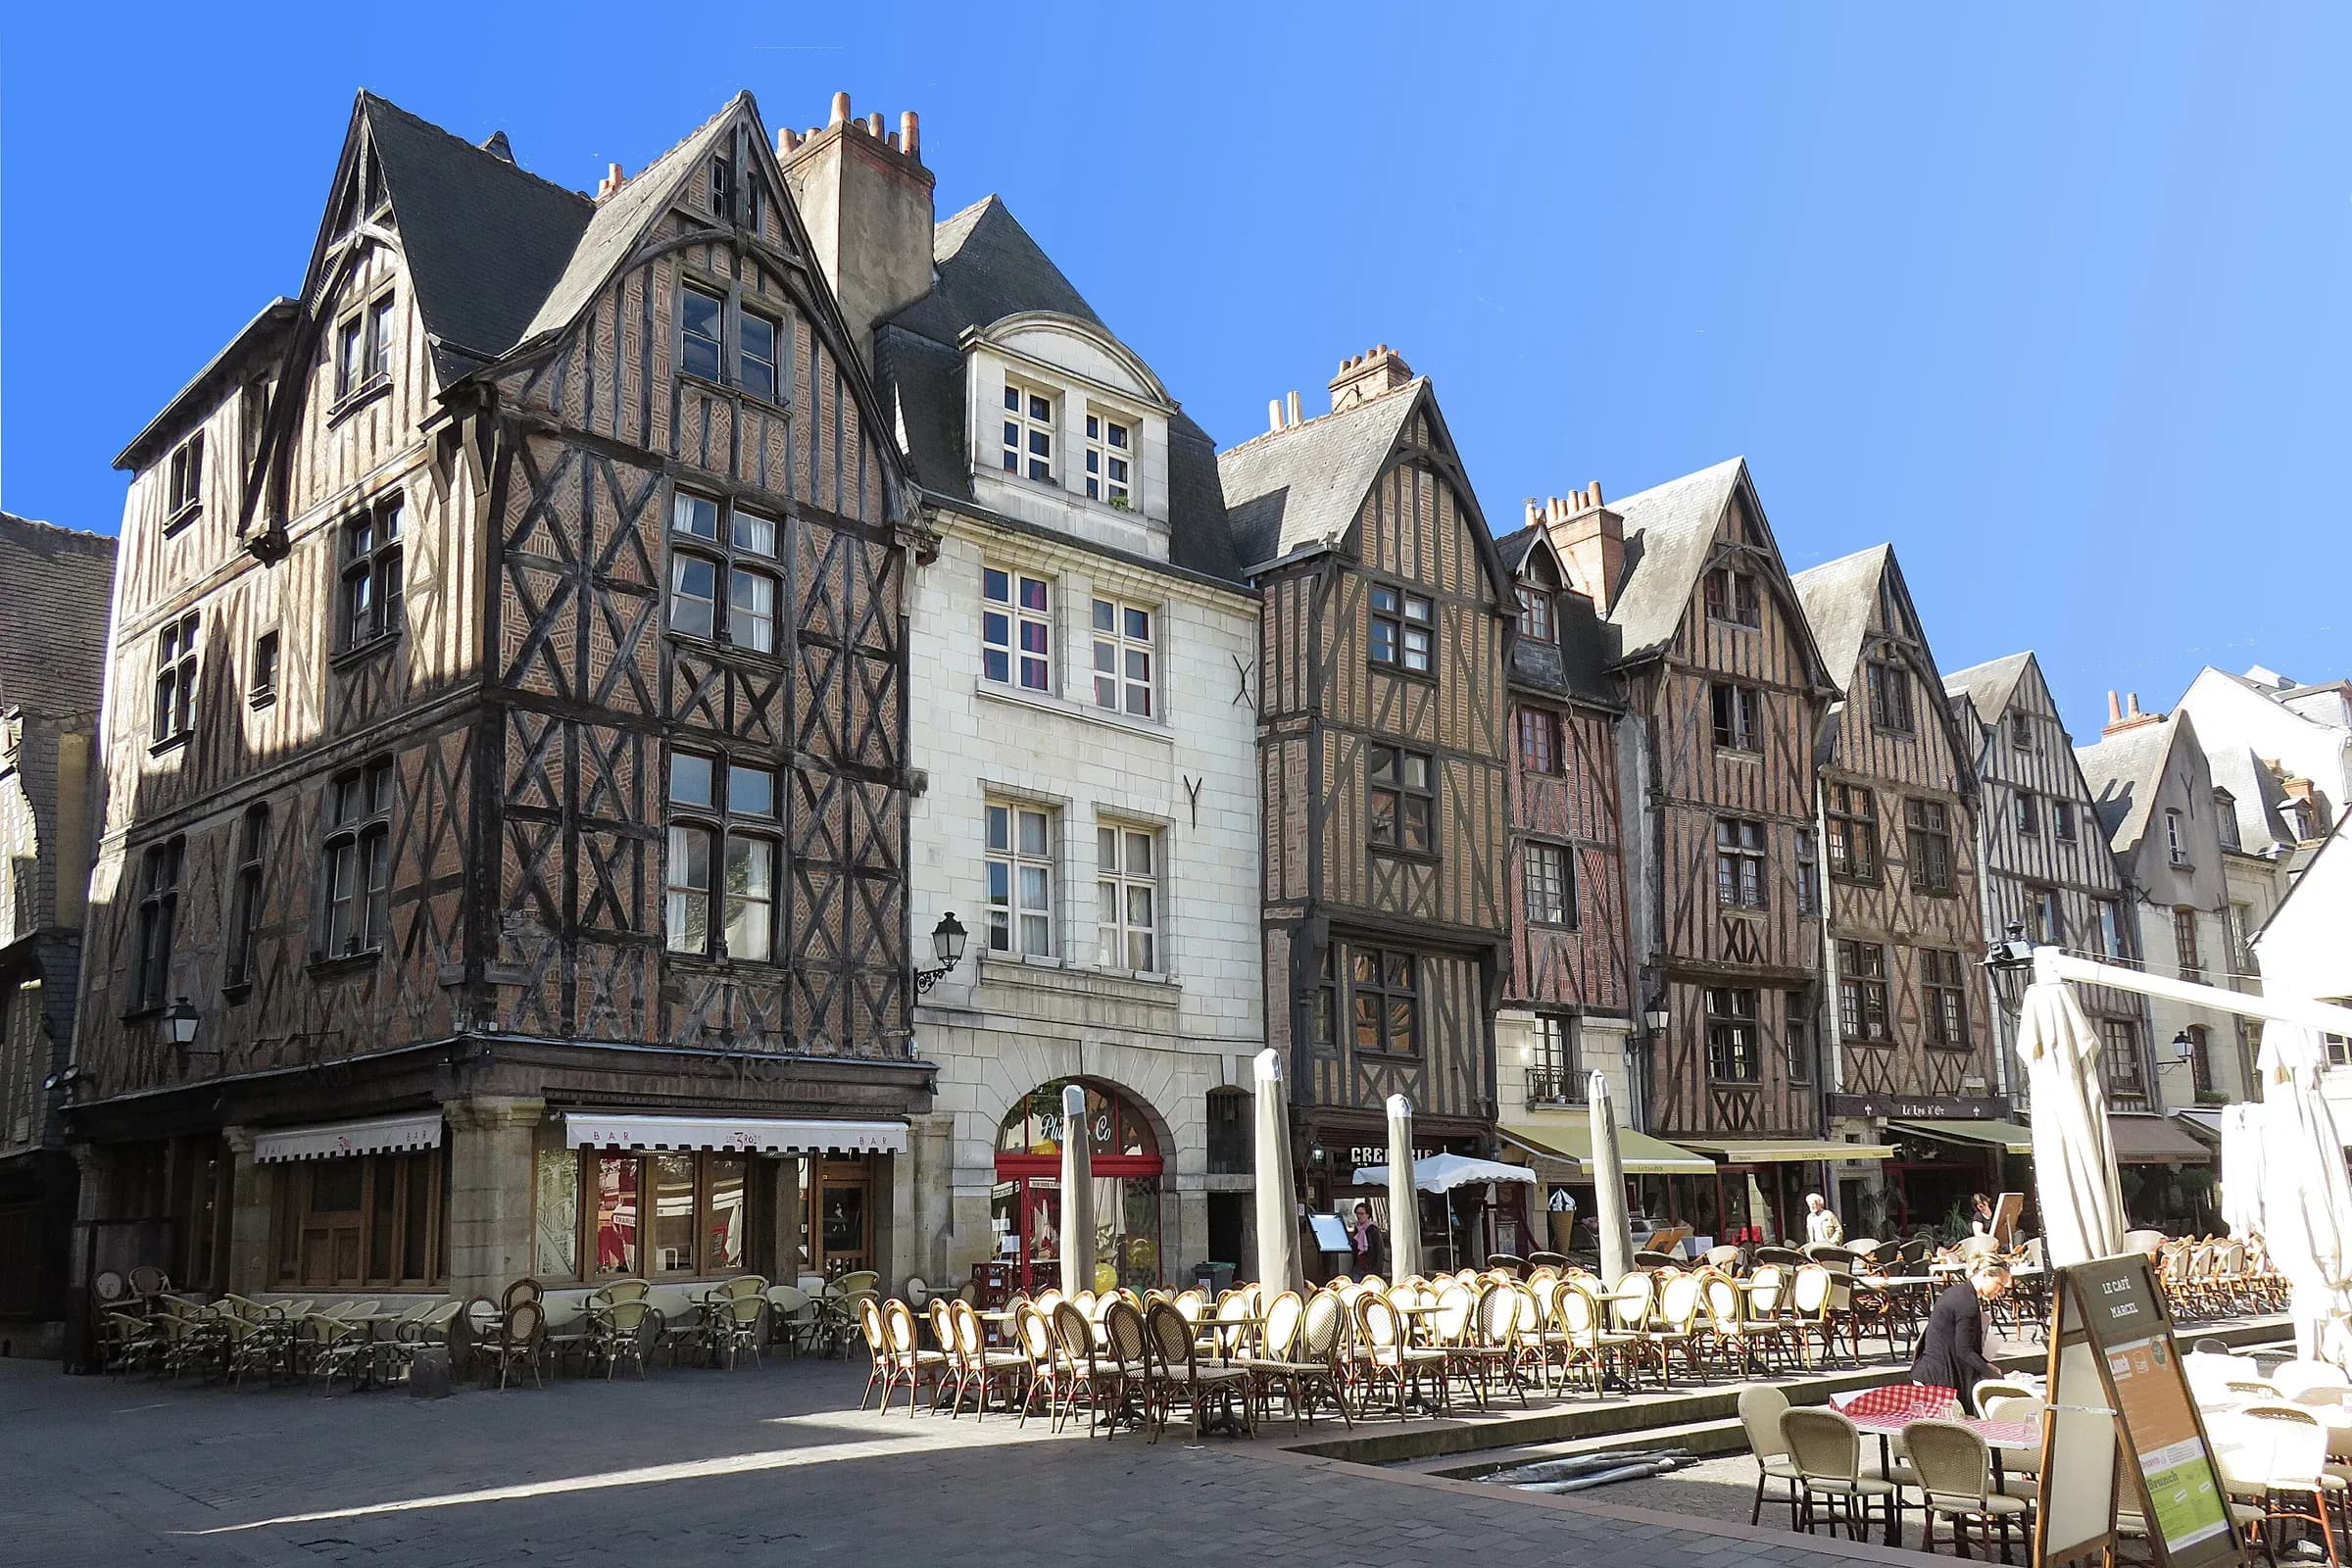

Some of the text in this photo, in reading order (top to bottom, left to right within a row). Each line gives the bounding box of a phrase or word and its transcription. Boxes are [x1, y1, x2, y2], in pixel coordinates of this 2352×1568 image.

[593, 1131, 630, 1141] BAR
[1096, 1115, 1111, 1142] Co
[859, 1136, 887, 1146] BAR
[2101, 1275, 2132, 1294] LE CAFÉ
[2147, 1471, 2180, 1491] Brunch
